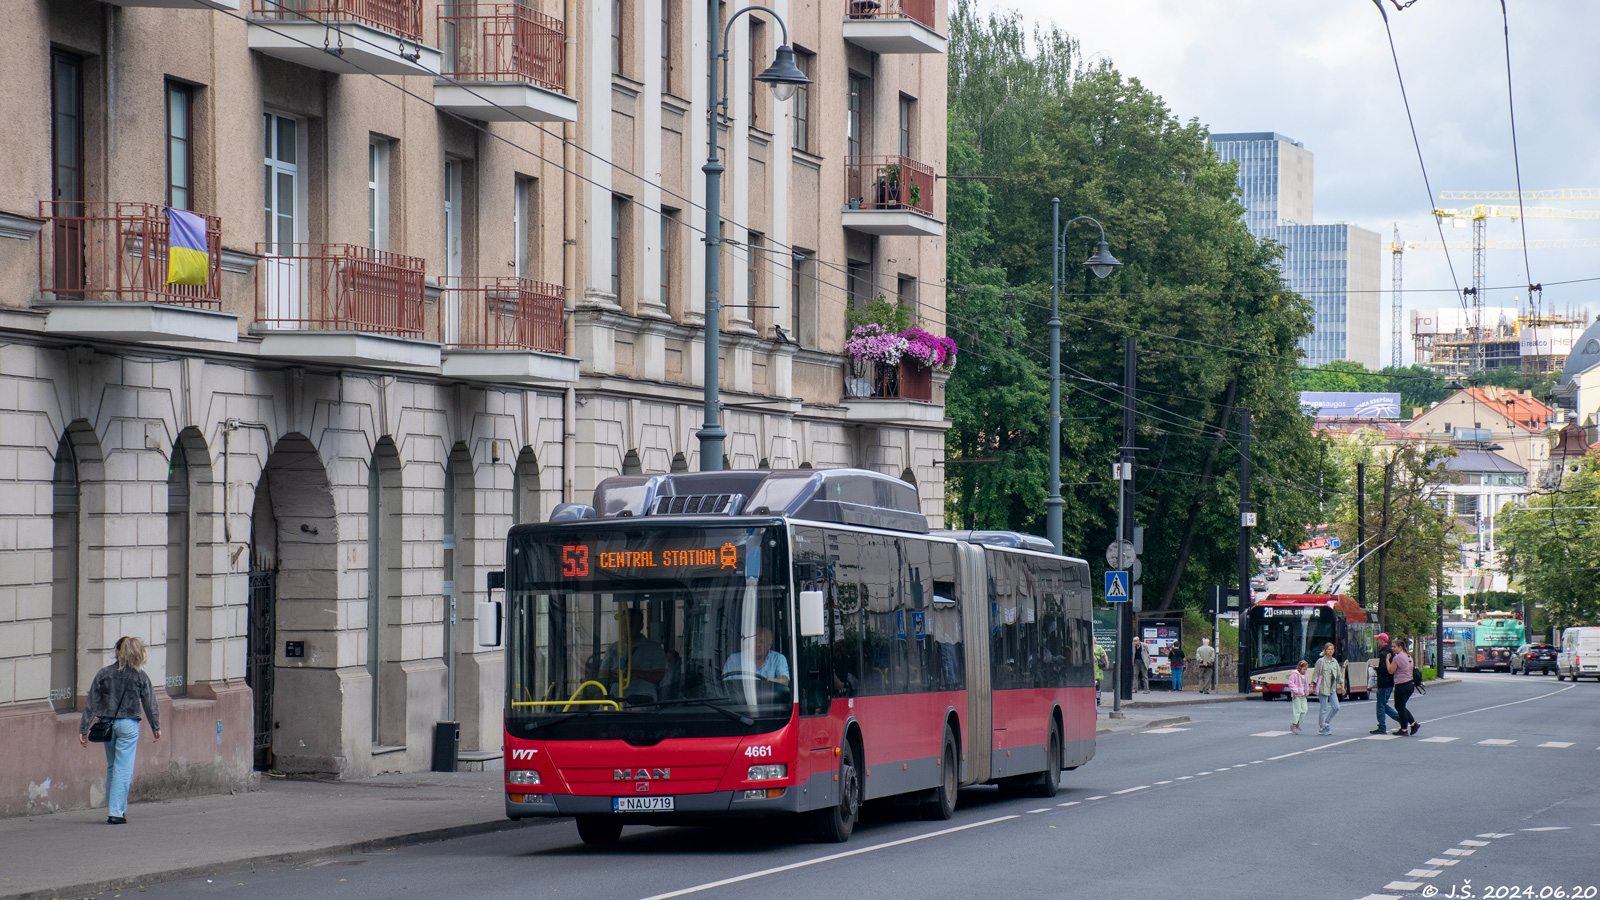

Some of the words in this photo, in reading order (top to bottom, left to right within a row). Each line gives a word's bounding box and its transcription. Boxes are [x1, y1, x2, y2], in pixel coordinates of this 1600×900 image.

[563, 545, 589, 577] 53
[600, 551, 658, 568] CENTRAL
[662, 550, 716, 566] STATION
[1264, 607, 1273, 618] 20
[744, 745, 772, 758] 4661
[613, 768, 671, 781] MAN
[626, 797, 671, 809] NAU719
